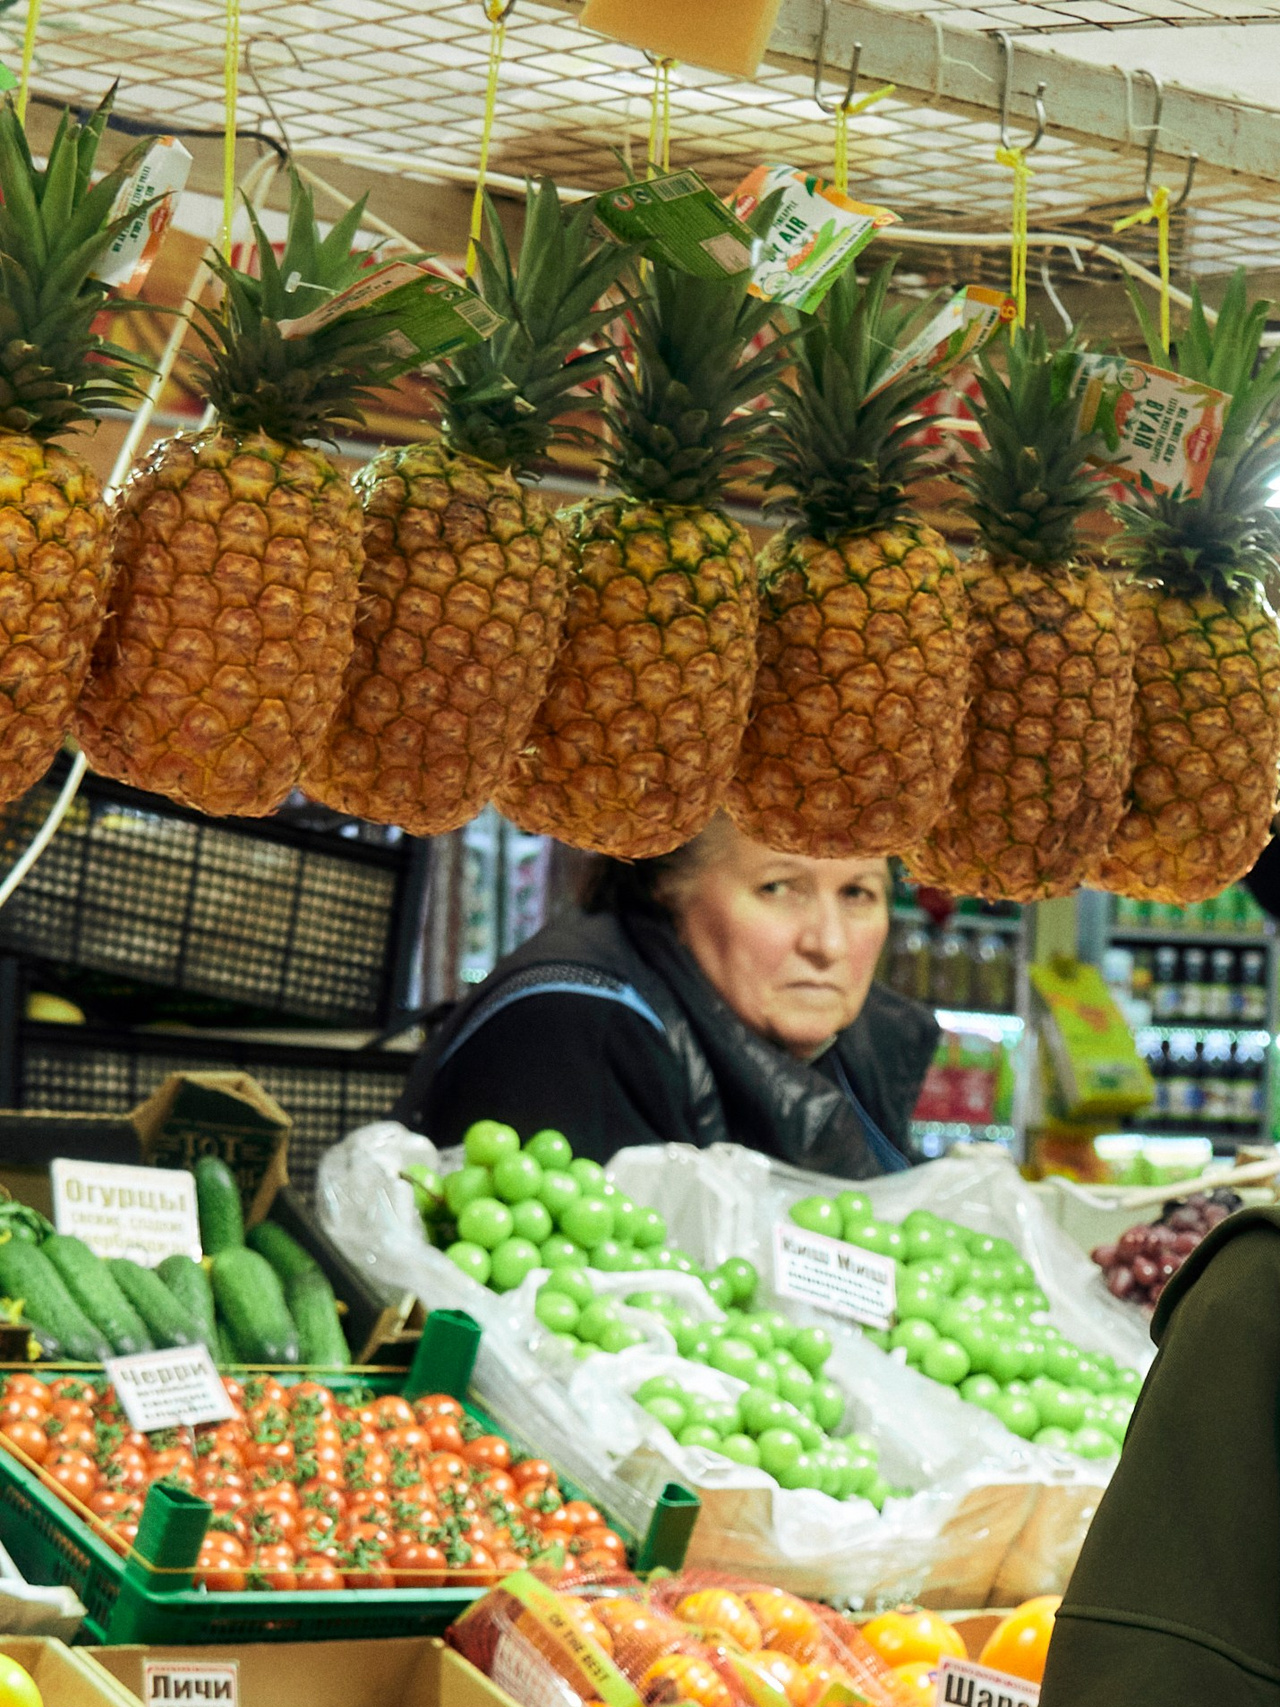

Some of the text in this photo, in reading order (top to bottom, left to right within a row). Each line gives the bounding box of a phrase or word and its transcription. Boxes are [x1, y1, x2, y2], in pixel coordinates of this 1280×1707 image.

[778, 216, 808, 245] AIR
[1132, 399, 1165, 449] BY AIR
[65, 1178, 187, 1212] Огурцы
[120, 1362, 208, 1386] Черри
[582, 1653, 609, 1683] BEST
[151, 1675, 232, 1699] Личи
